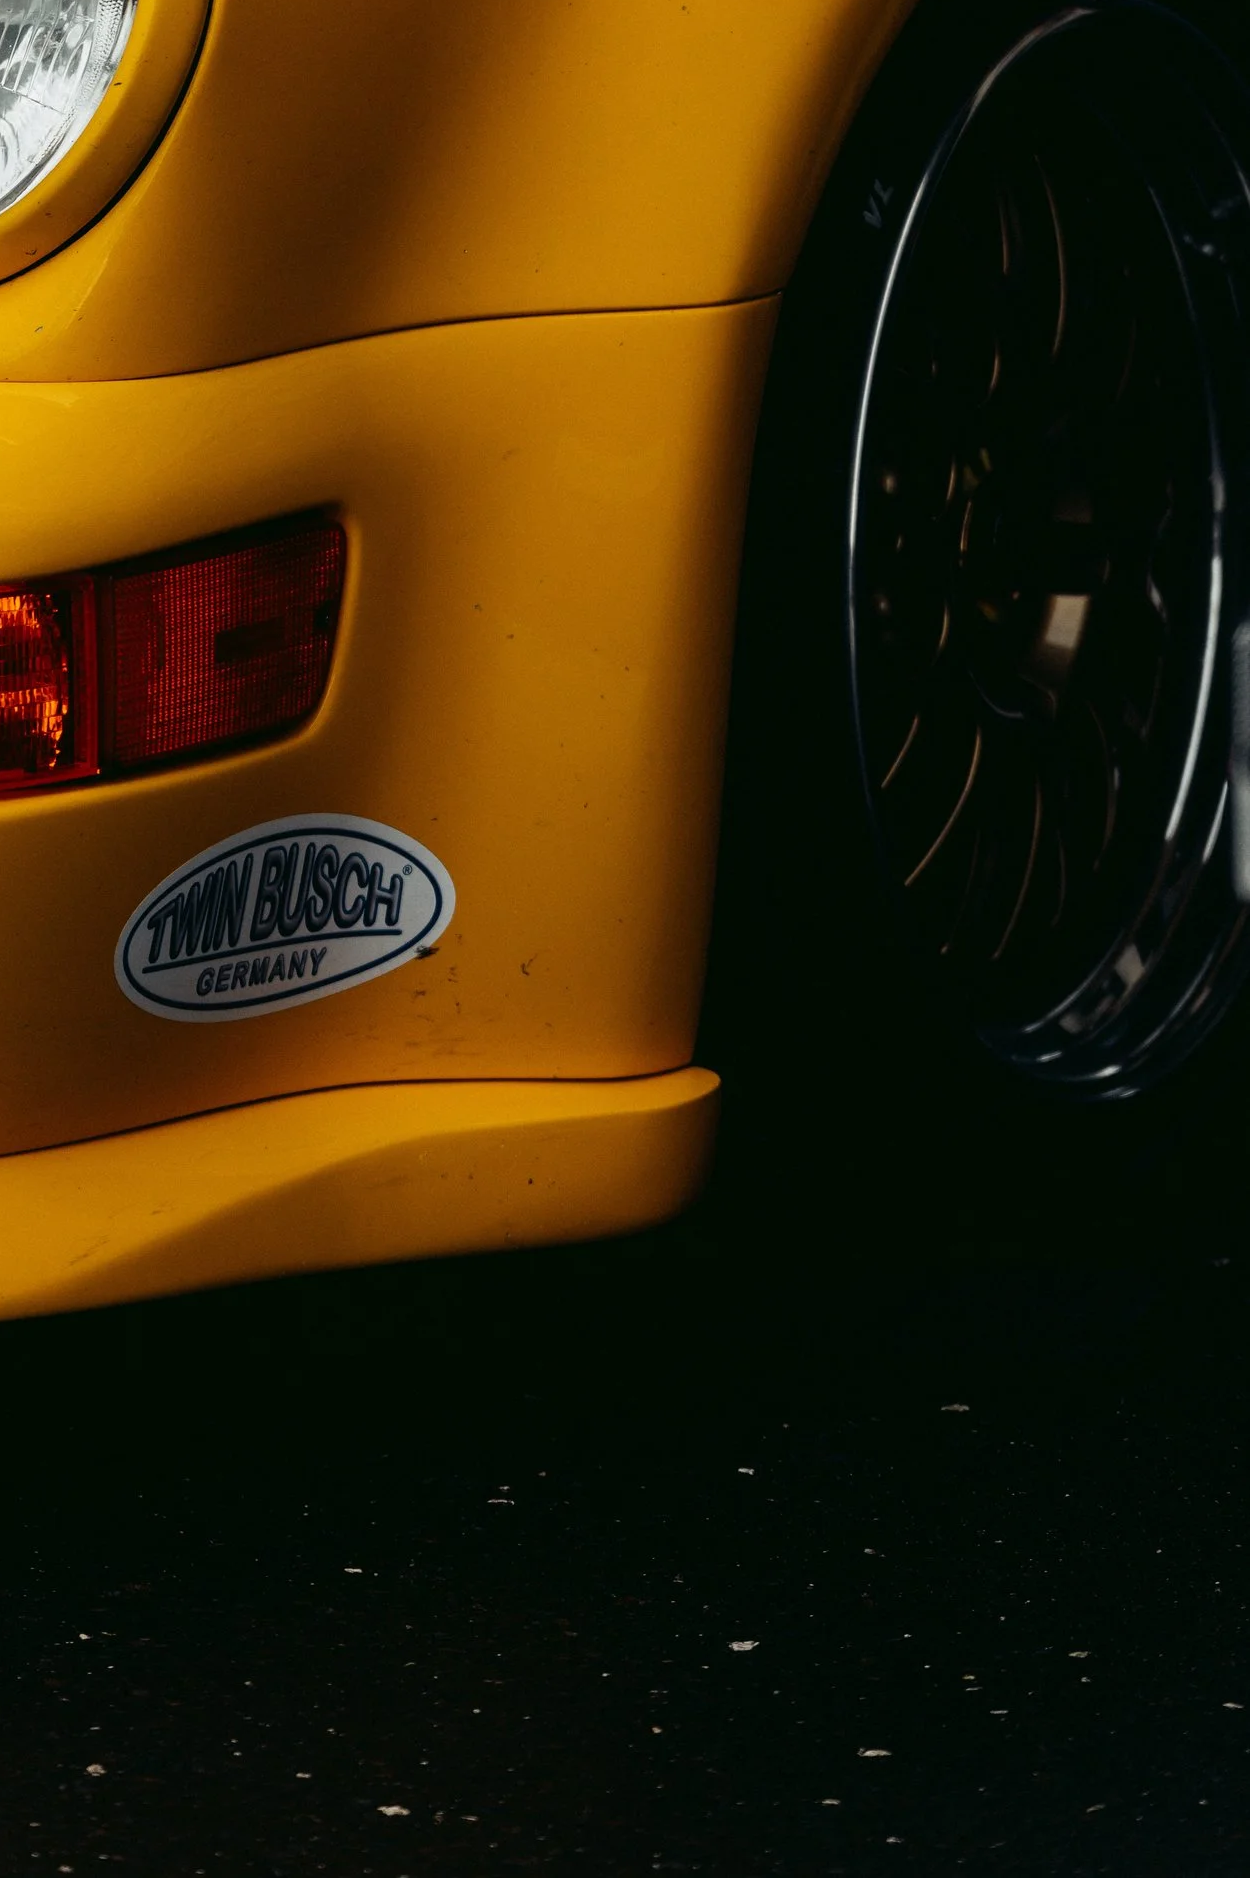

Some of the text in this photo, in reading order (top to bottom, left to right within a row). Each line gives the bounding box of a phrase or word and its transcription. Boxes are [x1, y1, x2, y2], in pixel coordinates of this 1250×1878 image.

[147, 841, 404, 964] TWIN BUSCH
[195, 946, 328, 998] GERMANY
